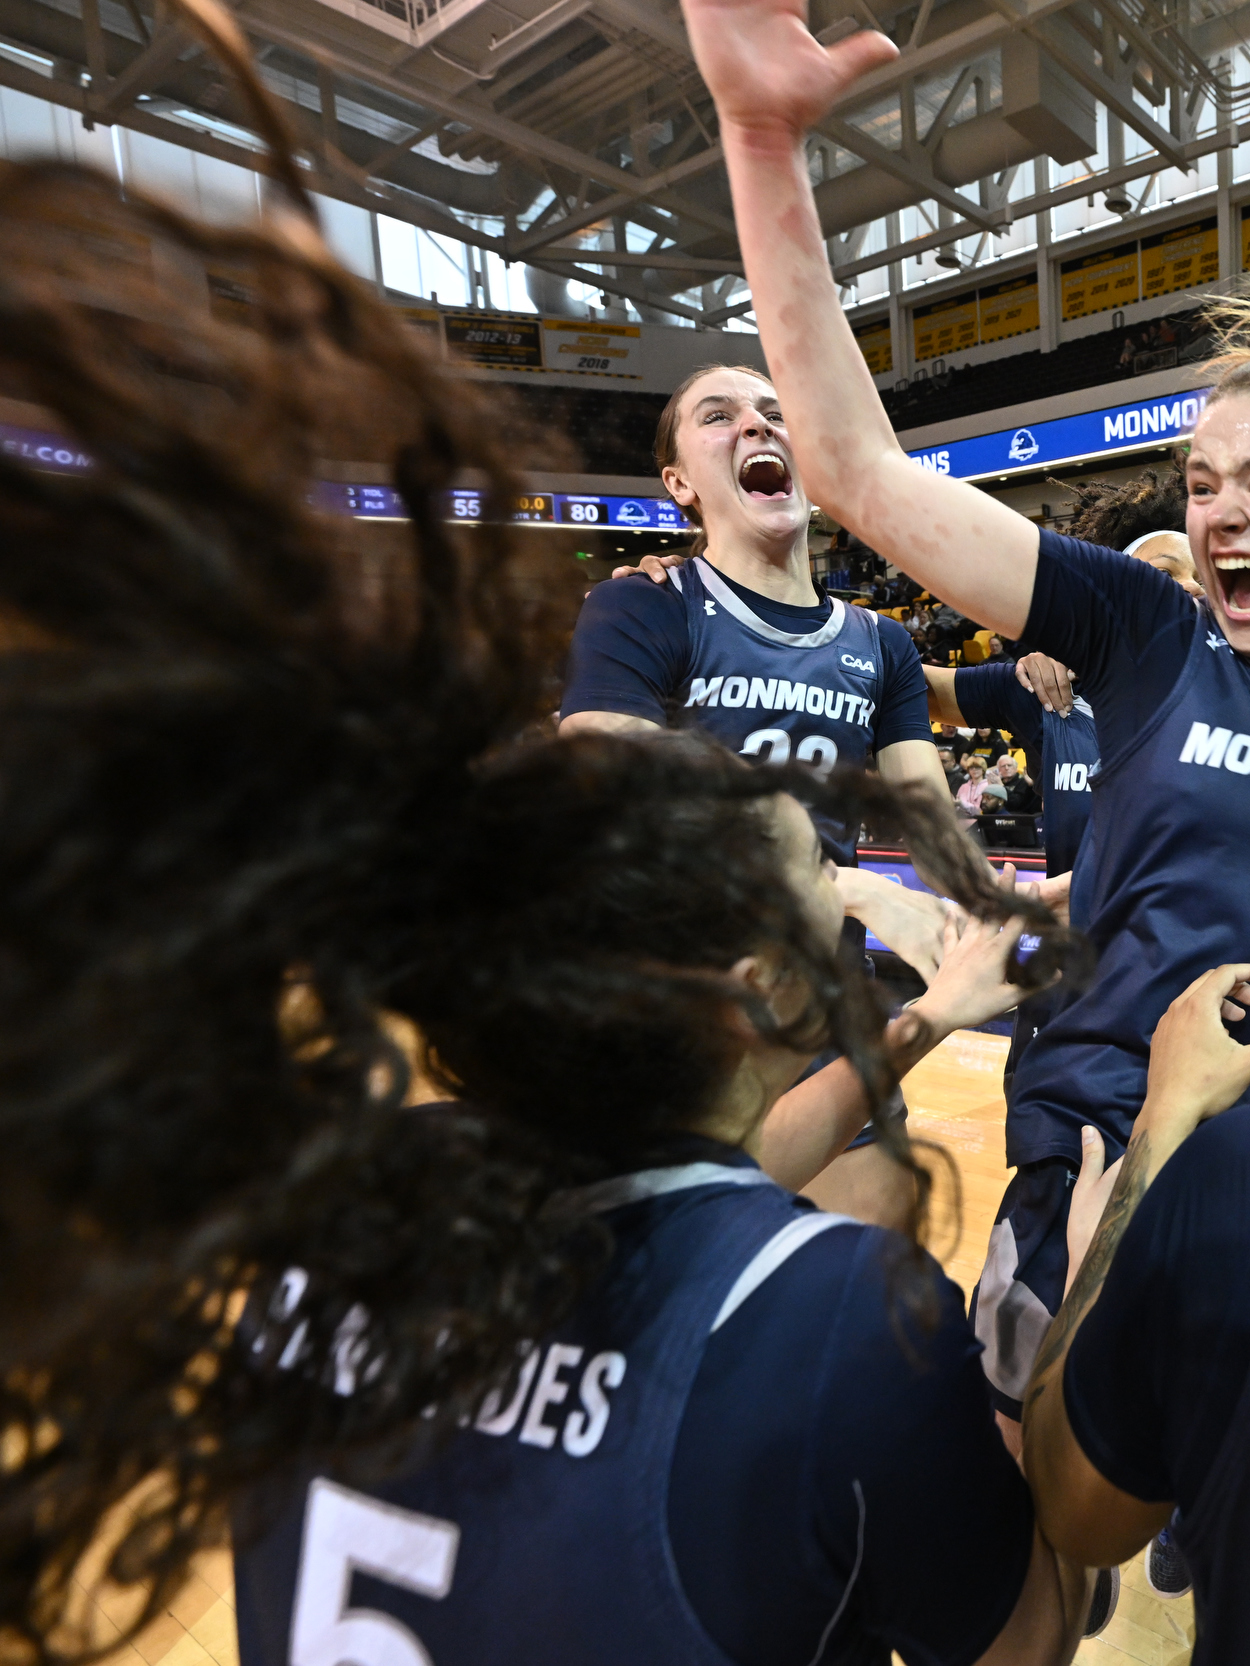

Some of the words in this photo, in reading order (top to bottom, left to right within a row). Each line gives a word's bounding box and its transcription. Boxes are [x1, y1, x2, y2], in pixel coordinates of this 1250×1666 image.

[465, 330, 522, 345] 2012-13
[577, 357, 610, 370] 2018
[454, 498, 481, 517] 55
[571, 504, 599, 522] 80
[841, 654, 875, 674] CAA
[684, 676, 876, 727] MONMOUTH
[288, 1476, 461, 1666] 5
